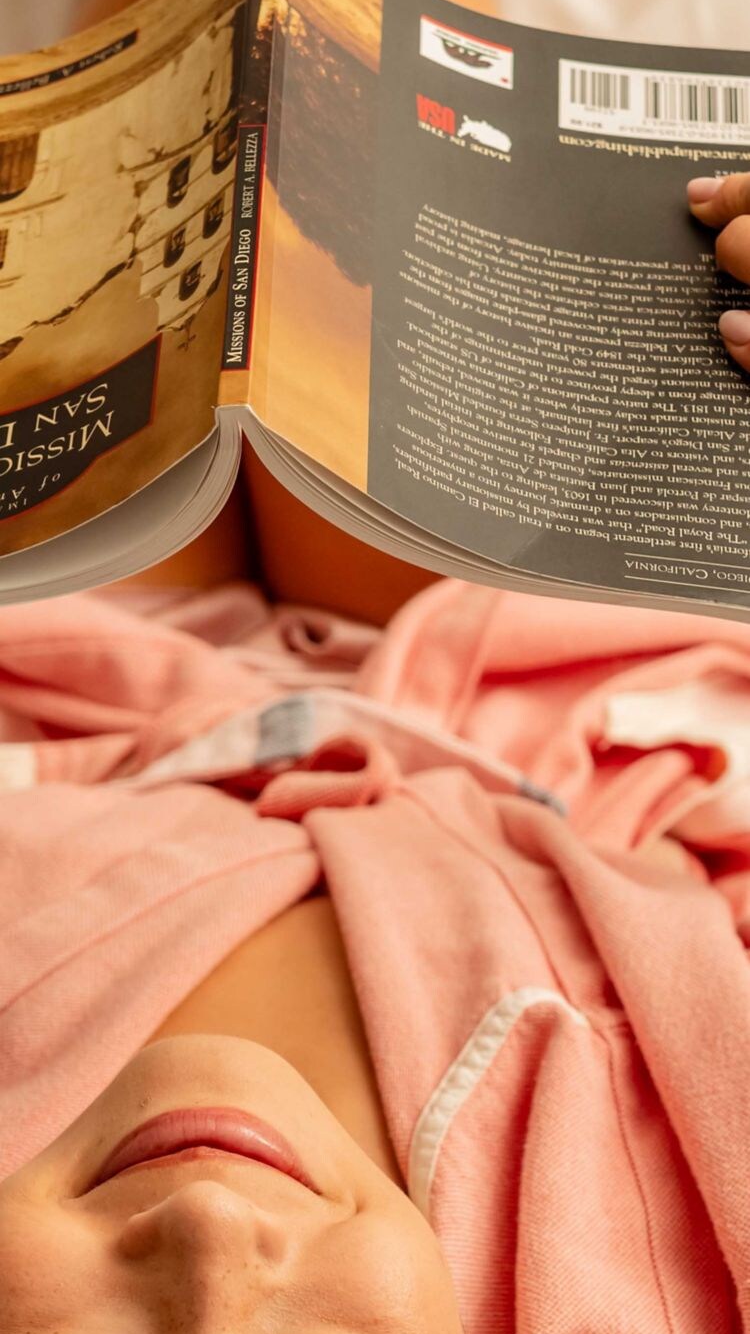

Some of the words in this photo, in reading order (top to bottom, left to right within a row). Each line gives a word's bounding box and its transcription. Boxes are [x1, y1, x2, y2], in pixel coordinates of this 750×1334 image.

[415, 93, 456, 136] USA
[417, 121, 445, 139] THE
[244, 132, 258, 171] BELLEZZA
[470, 143, 511, 162] MADE
[240, 185, 254, 218] ROBERT
[234, 229, 251, 265] DIEGO
[232, 267, 248, 291] SAN
[234, 294, 247, 308] OF
[431, 322, 448, 335] the
[226, 311, 246, 363] MISSIONS
[397, 338, 416, 353] and
[417, 338, 466, 366] witnessed
[463, 337, 543, 368] underpinnings
[564, 343, 593, 356] Gold
[623, 340, 668, 353] Bellezza
[418, 350, 454, 373] rebuilt,
[595, 349, 622, 360] 1849
[626, 353, 646, 363] the
[397, 362, 417, 380] San
[411, 360, 452, 384] presidio
[494, 360, 526, 375] status
[546, 363, 596, 378] powerful
[590, 360, 656, 374] settlements
[660, 367, 701, 377] earliest
[457, 368, 495, 389] moved,
[469, 362, 525, 388] California
[529, 371, 548, 383] the
[599, 373, 618, 384] the
[622, 376, 658, 387] forged
[399, 375, 438, 404] landing
[419, 374, 460, 401] Mission
[454, 380, 496, 400] original
[566, 379, 617, 393] province
[660, 379, 710, 388] missions
[498, 385, 519, 397] was
[541, 386, 609, 404] populations
[620, 386, 655, 399] sleepy
[668, 391, 696, 401] from
[699, 392, 742, 404] change
[33, 383, 108, 432] SAN
[440, 397, 472, 418] initial
[462, 395, 506, 419] founded
[498, 397, 517, 410] the
[533, 396, 567, 410] where
[570, 402, 612, 416] exactly
[612, 398, 648, 408] native
[652, 402, 676, 412] The
[680, 404, 708, 414] 1813.
[406, 404, 447, 431] Spanish
[424, 401, 479, 431] neophytes,
[475, 413, 494, 426] the
[508, 412, 539, 428] Serra
[534, 407, 592, 429] landmark,
[614, 410, 647, 421] today
[650, 414, 688, 423] stands
[691, 416, 735, 426] mission
[496, 419, 551, 444] Following
[541, 422, 591, 440] Junípero
[596, 421, 619, 432] first
[622, 425, 690, 437] California's
[396, 423, 443, 455] Explorers
[436, 432, 460, 448] with
[482, 427, 516, 444] native
[594, 433, 608, 443] Fr.
[612, 434, 658, 444] seaport,
[692, 428, 735, 440] Alcalá,
[450, 426, 518, 457] monumental
[519, 440, 535, 451] for
[555, 437, 618, 456] California.
[661, 438, 703, 450] Diego's
[706, 442, 730, 453] San
[412, 444, 466, 475] mysterious
[446, 449, 478, 467] quest.
[463, 443, 493, 462] along
[538, 446, 581, 462] chapels
[620, 448, 647, 458] Alta
[666, 451, 709, 461] visitors
[712, 455, 734, 464] and
[392, 444, 452, 481] pathfinders,
[496, 456, 529, 474] Anza,
[538, 457, 584, 476] founded
[584, 455, 606, 465] and
[609, 460, 669, 470] asistencias
[394, 457, 420, 480] Real,
[480, 464, 498, 476] the
[588, 468, 663, 482] missionaries,
[672, 464, 712, 473] several
[716, 467, 738, 477] and
[38, 473, 60, 491] of
[422, 474, 466, 501] Camino
[477, 475, 500, 489] into
[516, 474, 557, 495] leading
[549, 472, 596, 491] Bautista
[600, 482, 628, 494] Juan
[666, 476, 730, 491] Franciscan
[455, 477, 513, 505] missionary
[503, 483, 546, 504] journey
[561, 487, 590, 501] 1603,
[630, 485, 653, 495] and
[656, 487, 698, 500] Portolá
[611, 495, 674, 510] discovered
[719, 493, 750, 503] aspar
[482, 501, 515, 518] called
[550, 498, 602, 515] dramatic
[676, 502, 698, 510] was
[518, 514, 542, 527] trail
[533, 505, 579, 522] traveled
[634, 511, 716, 525] conquistadors
[582, 517, 604, 526] was
[608, 520, 632, 531] that
[719, 519, 742, 529] and
[574, 527, 610, 542] began
[635, 523, 675, 536] Road,”
[678, 527, 713, 541] Royal
[613, 533, 676, 547] settlement
[716, 532, 748, 544] “The
[679, 541, 702, 552] first
[624, 559, 708, 579] CALIFORNIA
